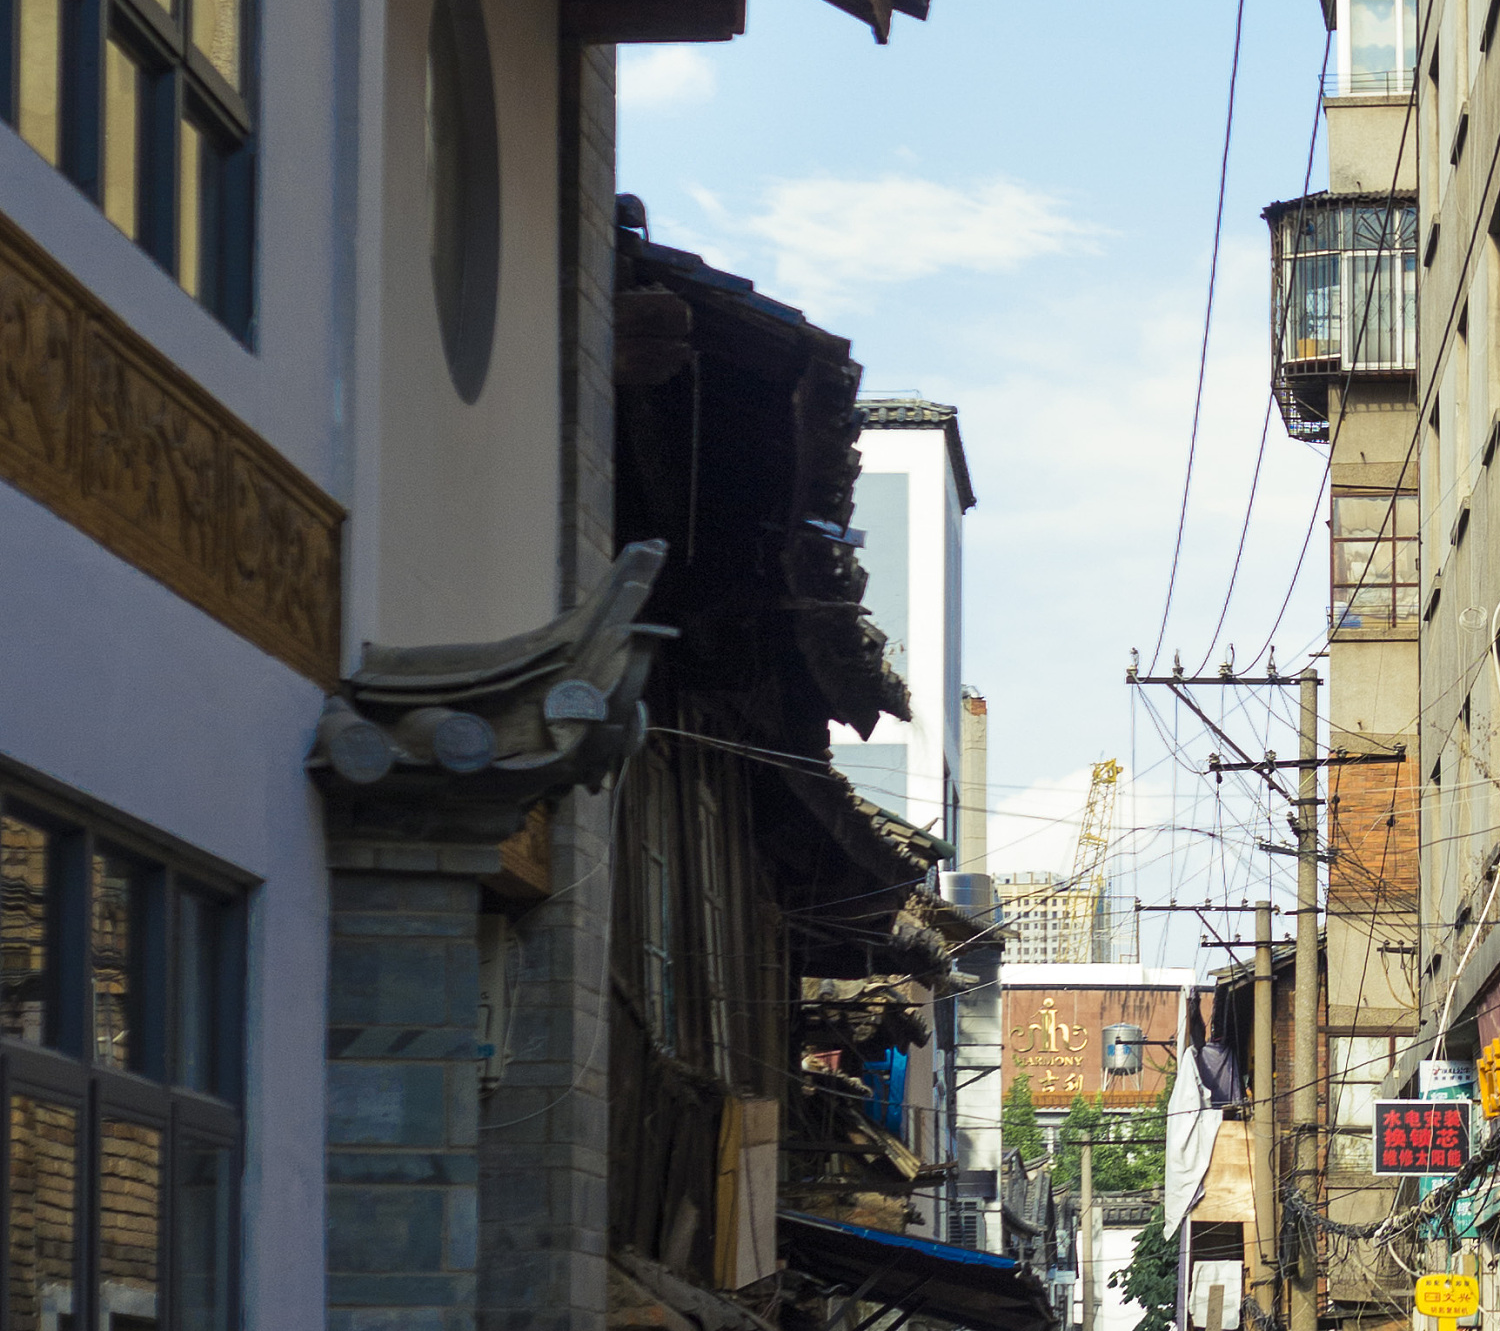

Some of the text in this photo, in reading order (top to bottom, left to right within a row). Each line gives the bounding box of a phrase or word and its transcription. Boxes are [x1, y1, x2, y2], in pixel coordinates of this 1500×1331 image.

[1383, 1110, 1462, 1129] 水电安装
[1383, 1129, 1460, 1149] 换锁芯
[1382, 1149, 1462, 1168] 维修太阳能
